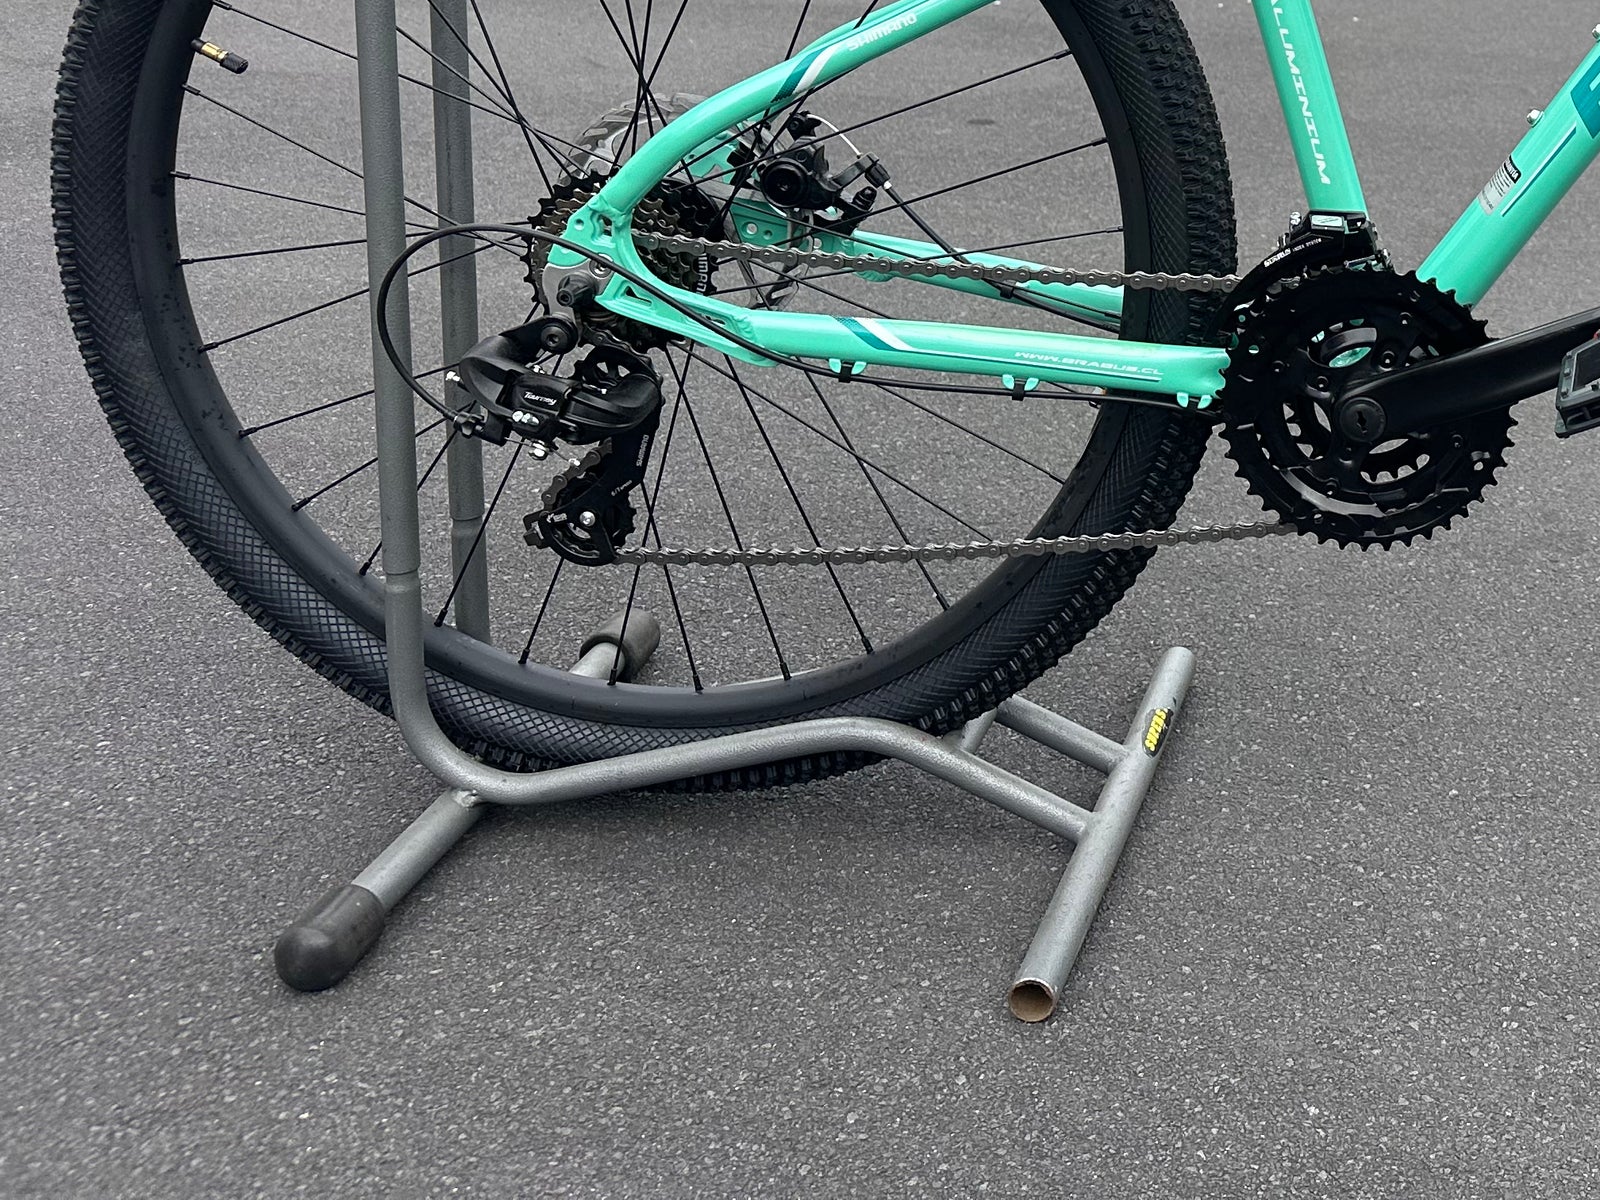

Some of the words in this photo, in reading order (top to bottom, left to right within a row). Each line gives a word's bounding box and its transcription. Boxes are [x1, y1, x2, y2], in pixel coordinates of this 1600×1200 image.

[847, 12, 918, 51] SHIMANO
[523, 391, 558, 406] Tourney
[636, 434, 650, 468] SHIMANO
